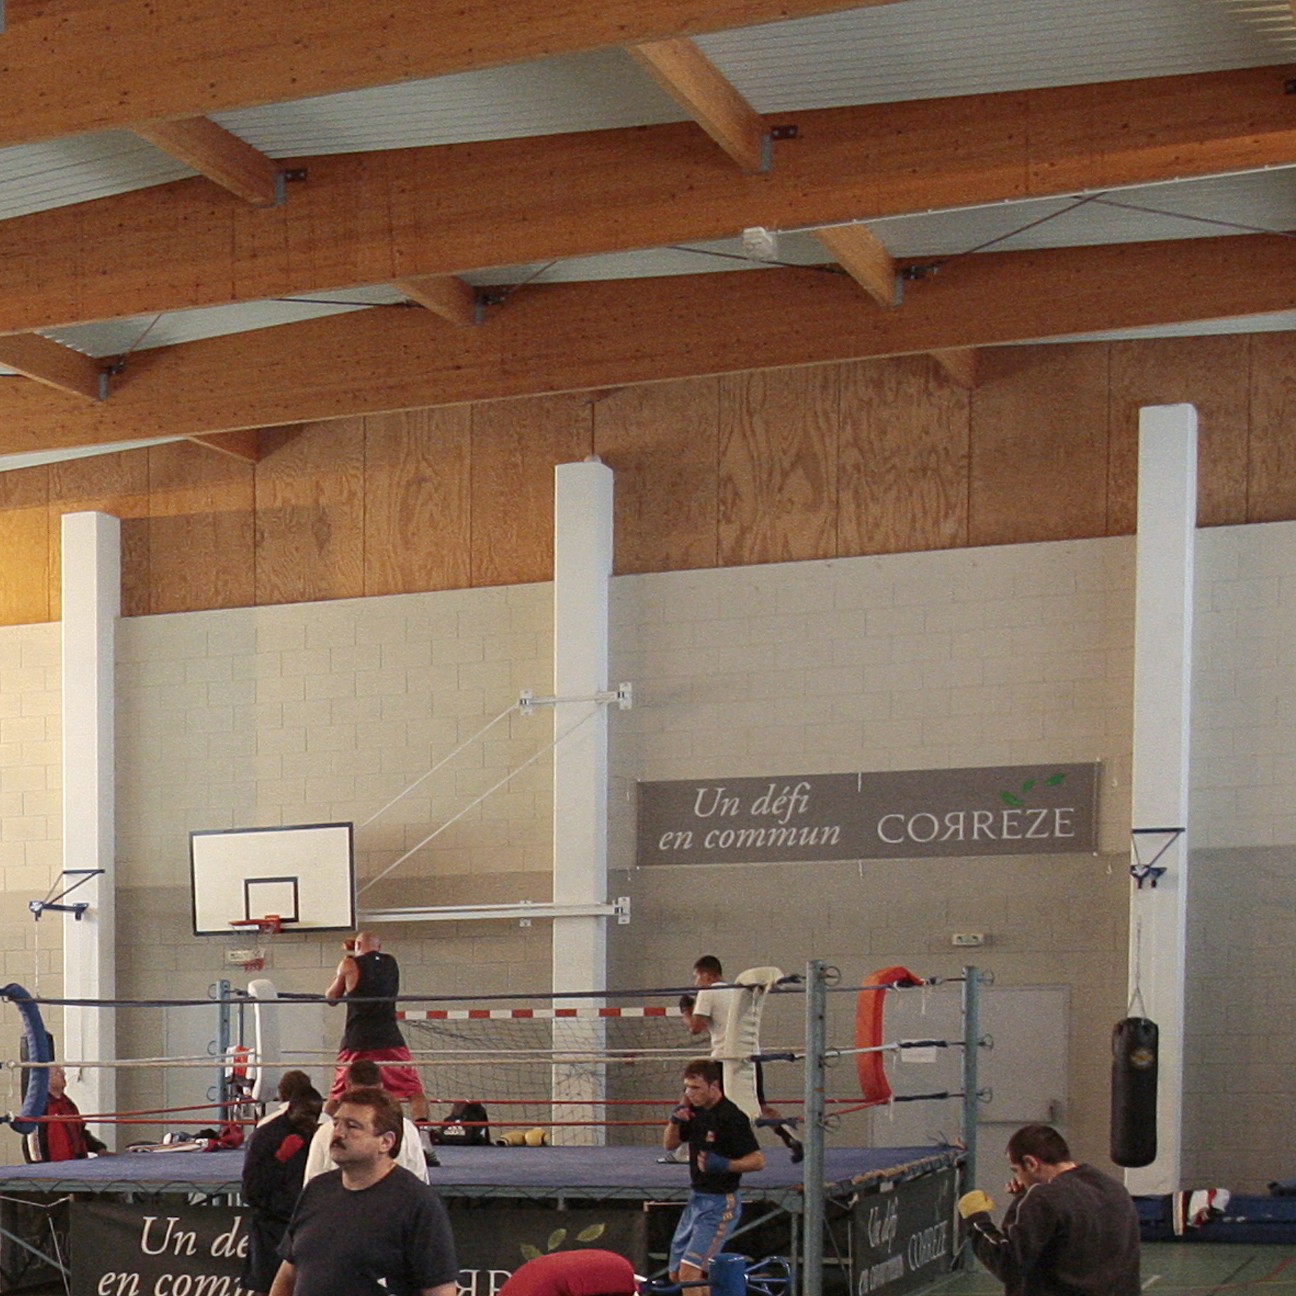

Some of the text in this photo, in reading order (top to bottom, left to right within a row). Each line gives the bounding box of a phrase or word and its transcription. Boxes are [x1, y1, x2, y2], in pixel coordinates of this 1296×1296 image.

[693, 782, 810, 824] Un défi
[658, 822, 840, 850] en commun
[140, 1215, 197, 1257] Un
